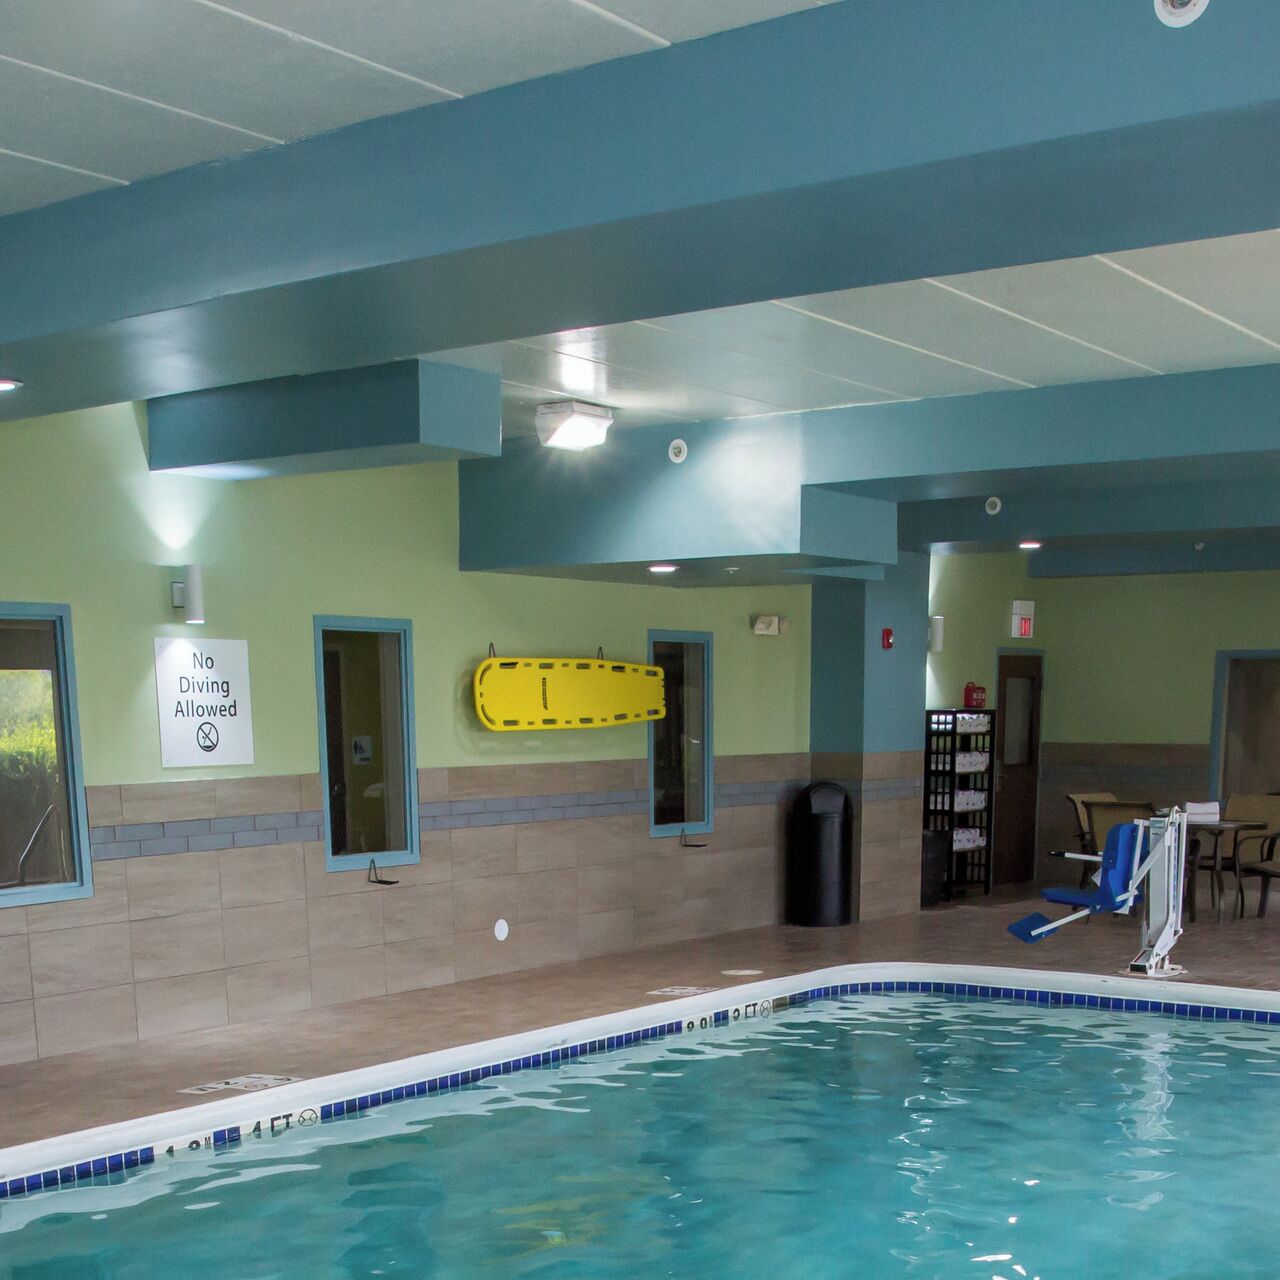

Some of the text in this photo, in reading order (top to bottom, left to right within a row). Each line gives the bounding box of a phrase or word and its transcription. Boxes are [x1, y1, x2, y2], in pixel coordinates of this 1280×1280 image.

[193, 652, 214, 669] No
[179, 676, 230, 698] Diving
[174, 700, 237, 718] Allowed
